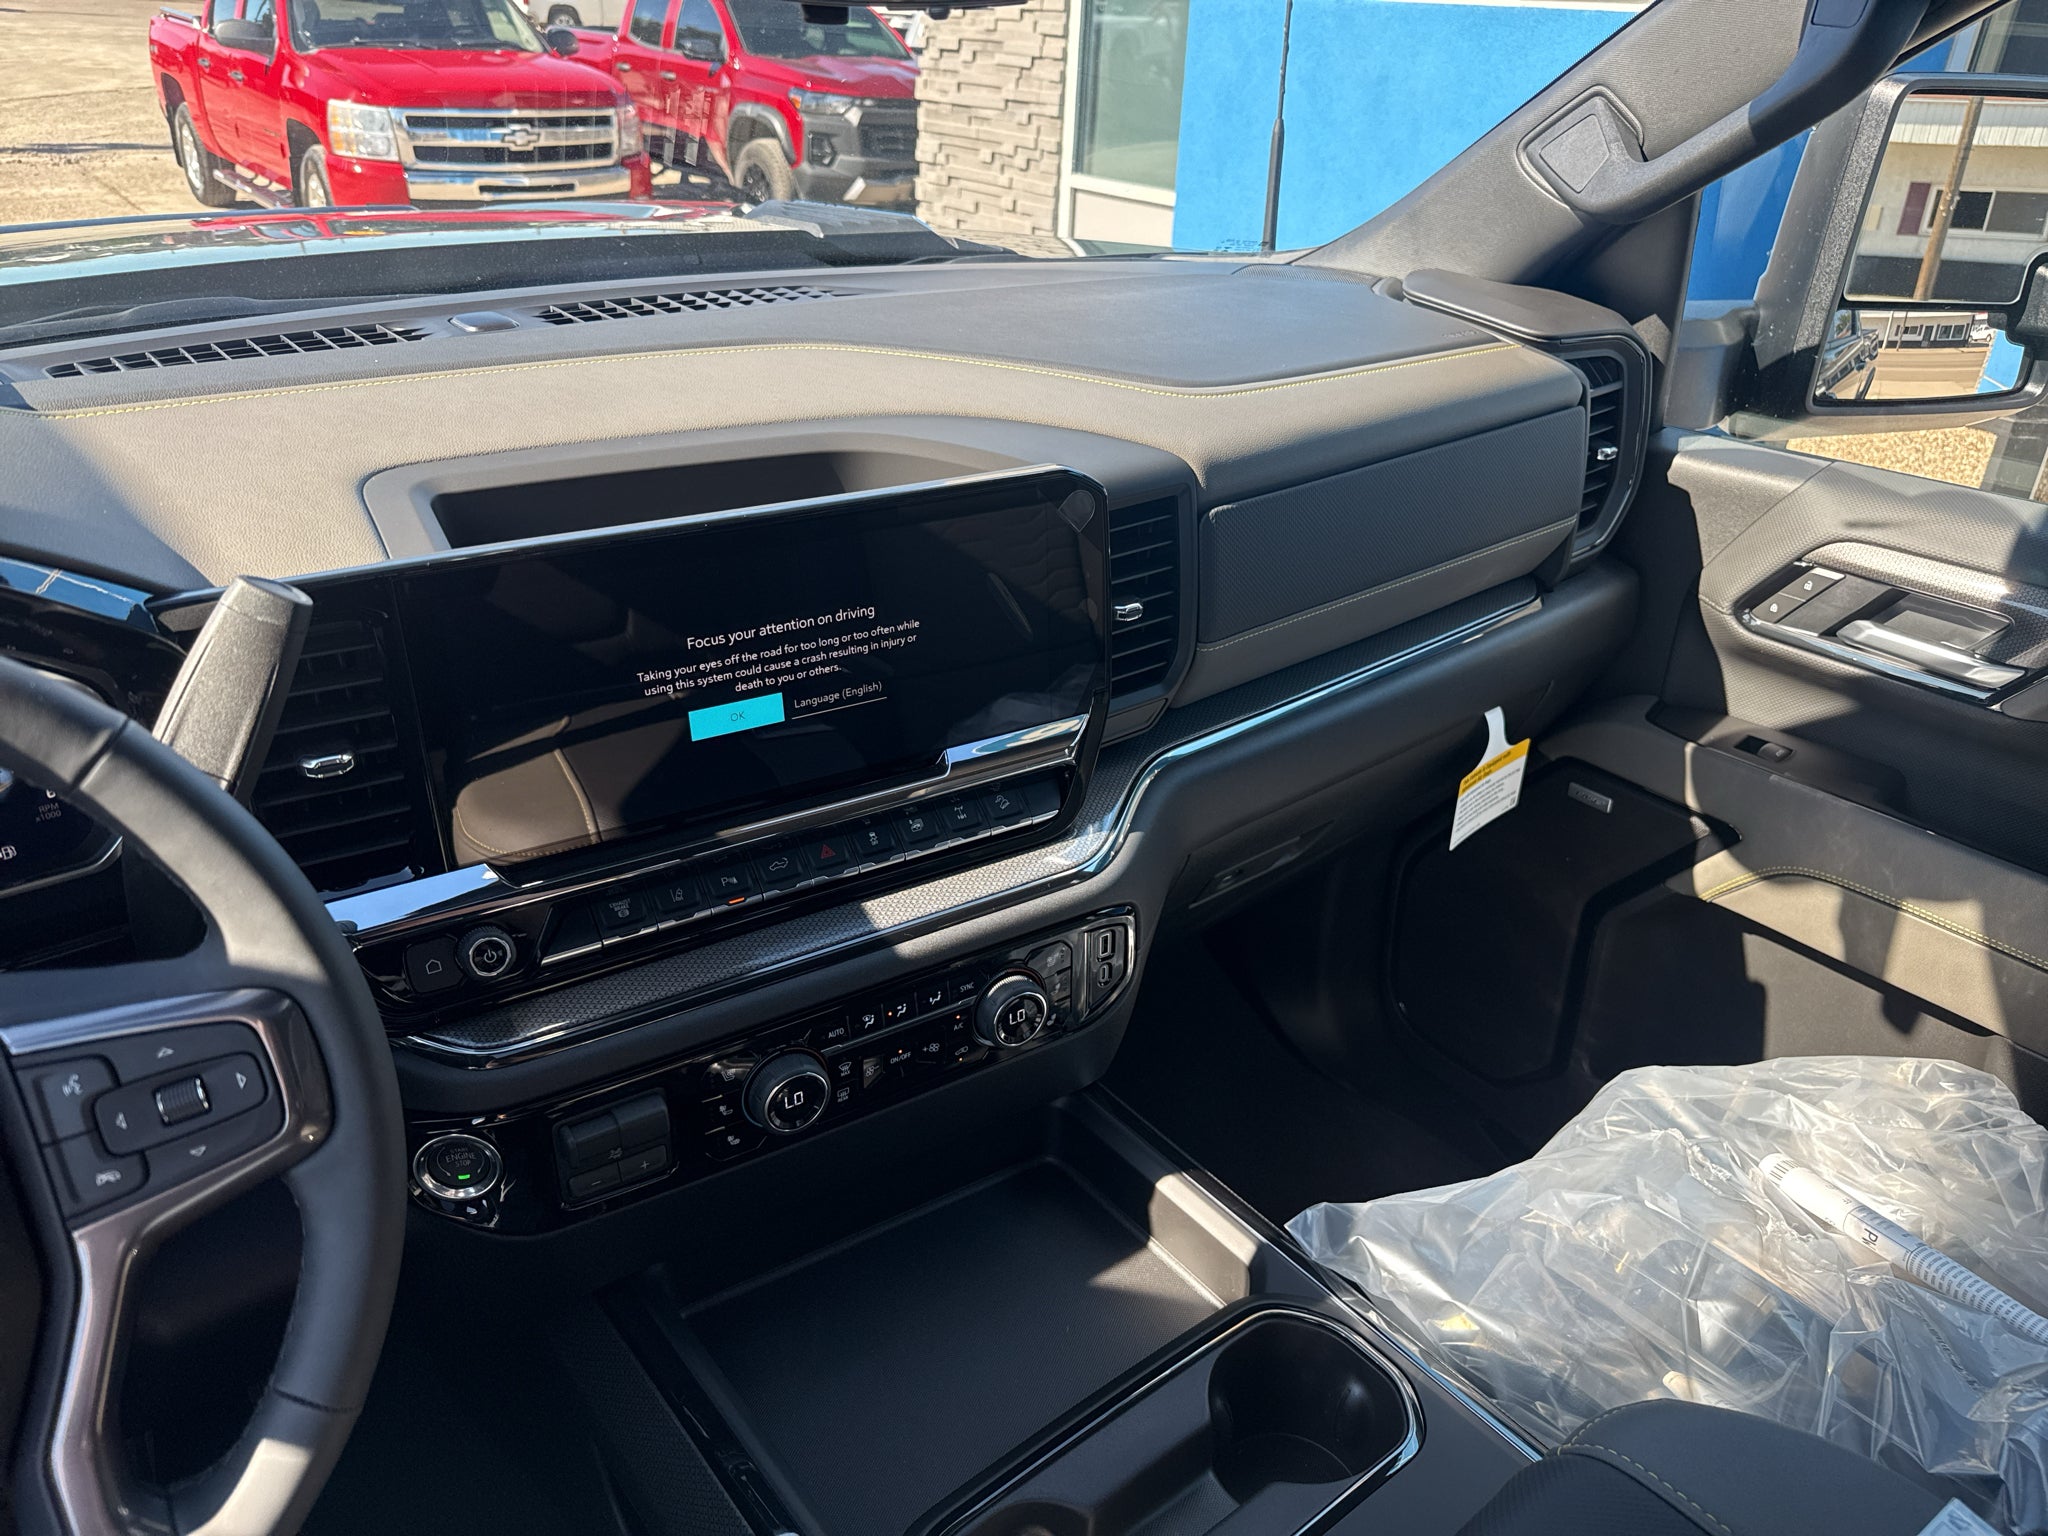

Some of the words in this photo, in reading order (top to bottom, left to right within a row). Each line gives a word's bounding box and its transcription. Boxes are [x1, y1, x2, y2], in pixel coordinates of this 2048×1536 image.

[686, 633, 726, 650] Focus
[728, 628, 756, 645] your
[759, 618, 815, 636] attention
[817, 614, 833, 625] on
[835, 606, 875, 622] driving
[636, 667, 672, 683] Taking
[674, 663, 697, 678] your
[699, 660, 723, 672] eyes
[724, 654, 741, 666] off
[742, 650, 758, 662] the
[760, 646, 783, 659] road
[784, 642, 799, 654] for
[800, 639, 817, 651] too
[818, 634, 840, 649] long
[841, 634, 852, 643] or
[853, 630, 870, 641] too
[870, 624, 896, 638] often
[896, 619, 920, 633] while
[644, 682, 673, 696] using
[675, 678, 695, 690] this
[697, 672, 733, 687] system
[734, 665, 762, 678] could
[764, 660, 792, 672] cause
[793, 658, 800, 666] a
[801, 652, 828, 666] crash
[829, 643, 869, 659] resulting
[870, 640, 879, 650] in
[880, 636, 906, 650] injury
[907, 634, 917, 644] or
[735, 679, 764, 692] death
[765, 675, 776, 686] to
[778, 672, 795, 686] you
[797, 670, 807, 679] or
[808, 664, 842, 678] others.
[794, 692, 840, 708] Language
[842, 681, 882, 700] (English)
[730, 711, 745, 722] OK
[38, 802, 59, 813] RPM
[959, 981, 975, 992] SYNC
[1009, 1008, 1026, 1026] LO
[953, 1021, 964, 1031] A/C
[828, 1027, 845, 1039] AUTO
[890, 1052, 912, 1065] ON/OFF
[784, 1091, 804, 1110] LO
[445, 1152, 477, 1163] ENGINE
[455, 1160, 472, 1168] STOP
